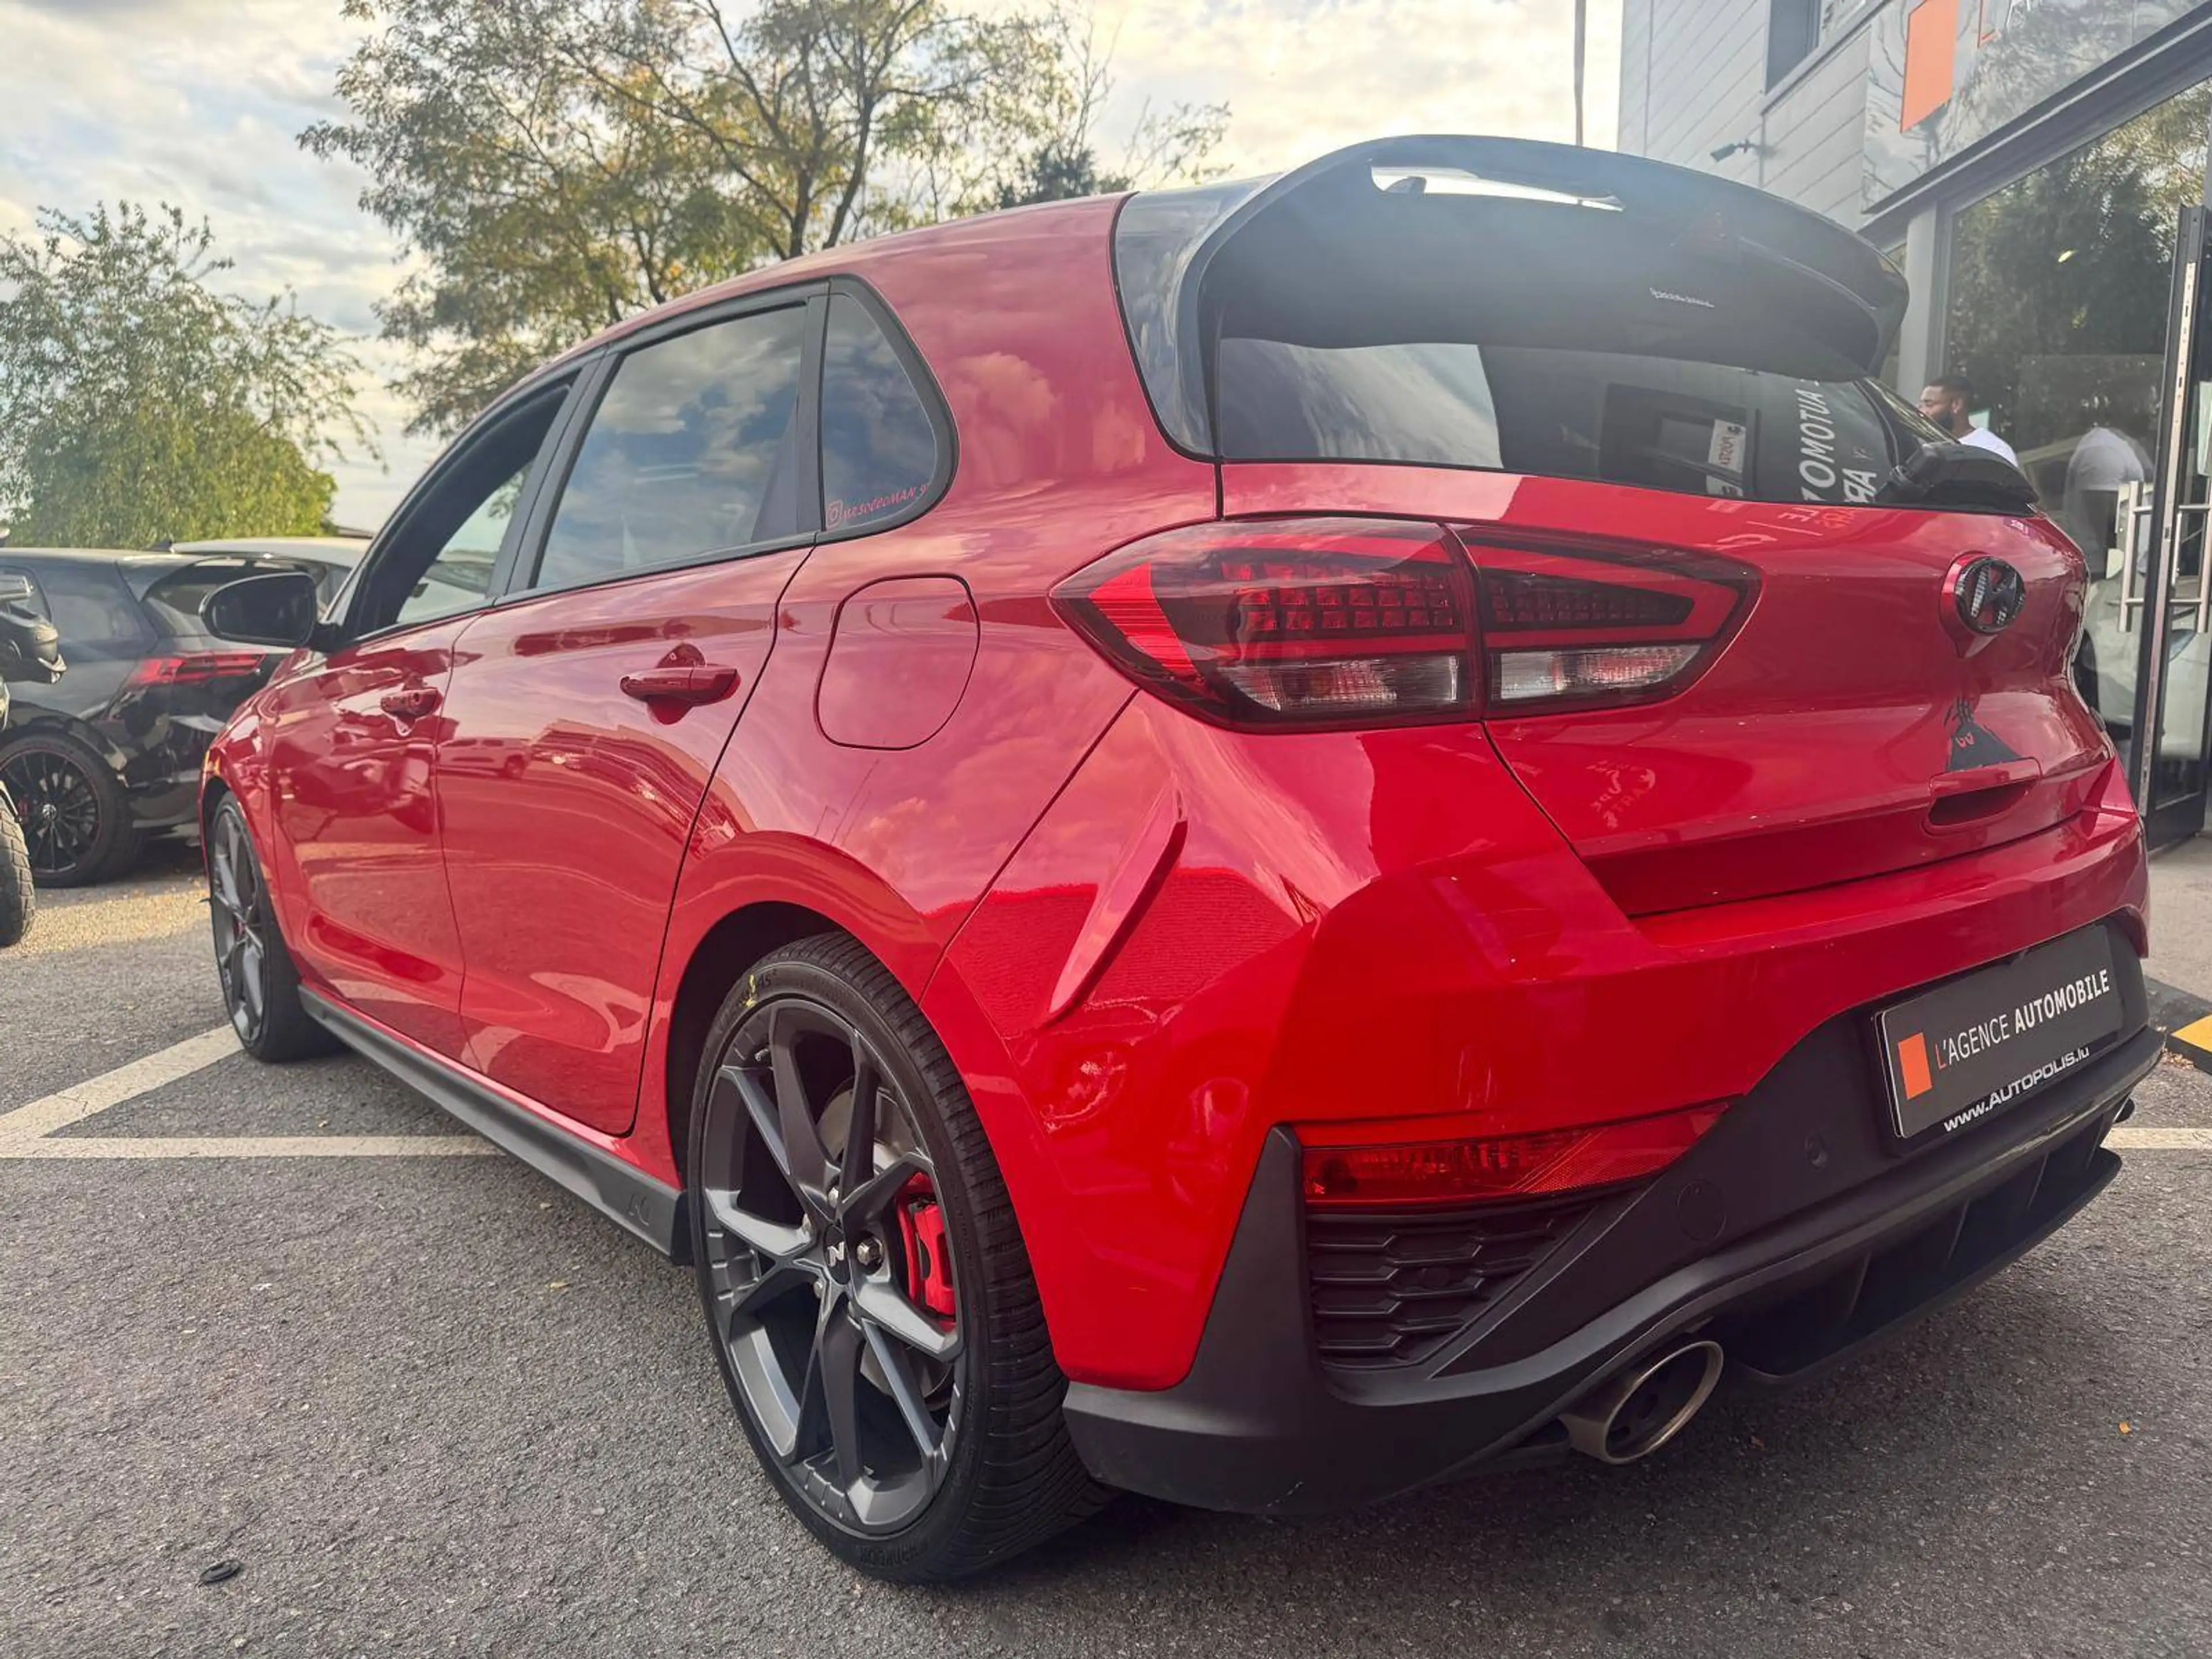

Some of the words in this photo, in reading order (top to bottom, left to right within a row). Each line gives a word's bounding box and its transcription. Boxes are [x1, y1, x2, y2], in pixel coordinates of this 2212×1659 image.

[1934, 1014, 2010, 1070] L'AGENCE
[2014, 969, 2110, 1035] AUTOMOBILE
[1943, 1046, 2090, 1132] www.AUTOPOLIS.lu
